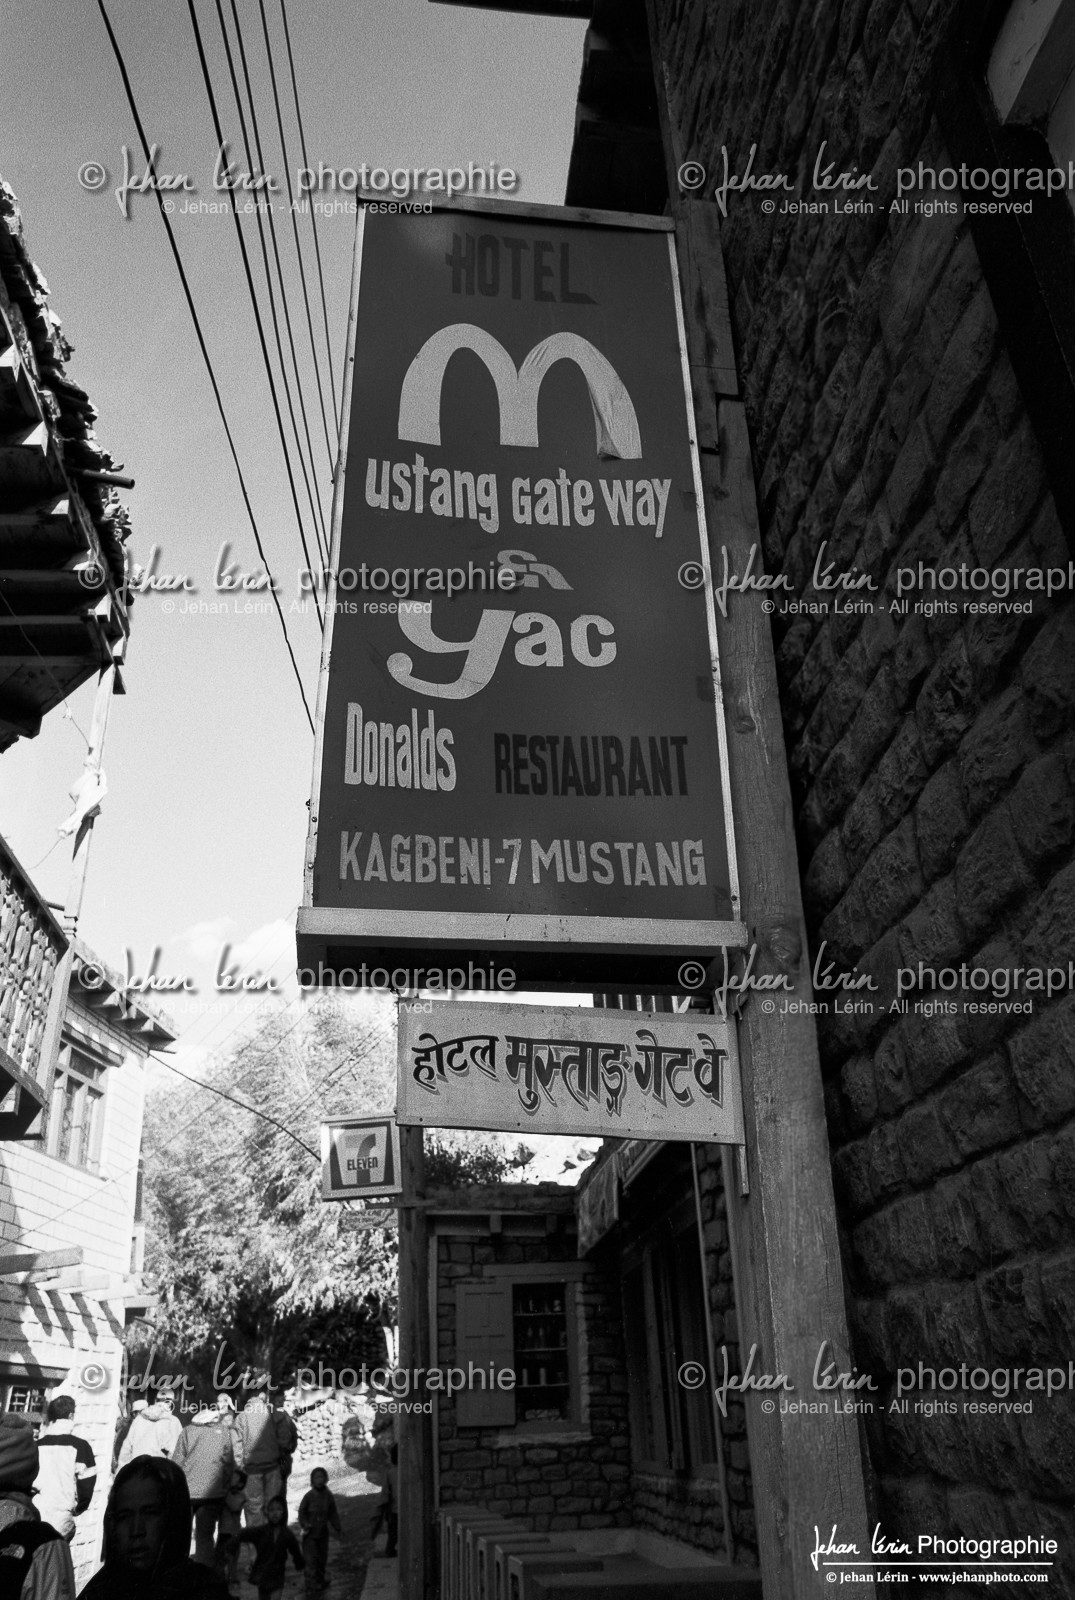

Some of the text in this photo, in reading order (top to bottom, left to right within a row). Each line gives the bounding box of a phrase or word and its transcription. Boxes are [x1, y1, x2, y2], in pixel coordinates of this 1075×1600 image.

[445, 232, 598, 305] HOTEL
[365, 453, 499, 533] ustang
[344, 702, 688, 797] Donalds RESTAURANT
[530, 839, 707, 886] MUSTANG
[411, 1033, 500, 1094] होटल
